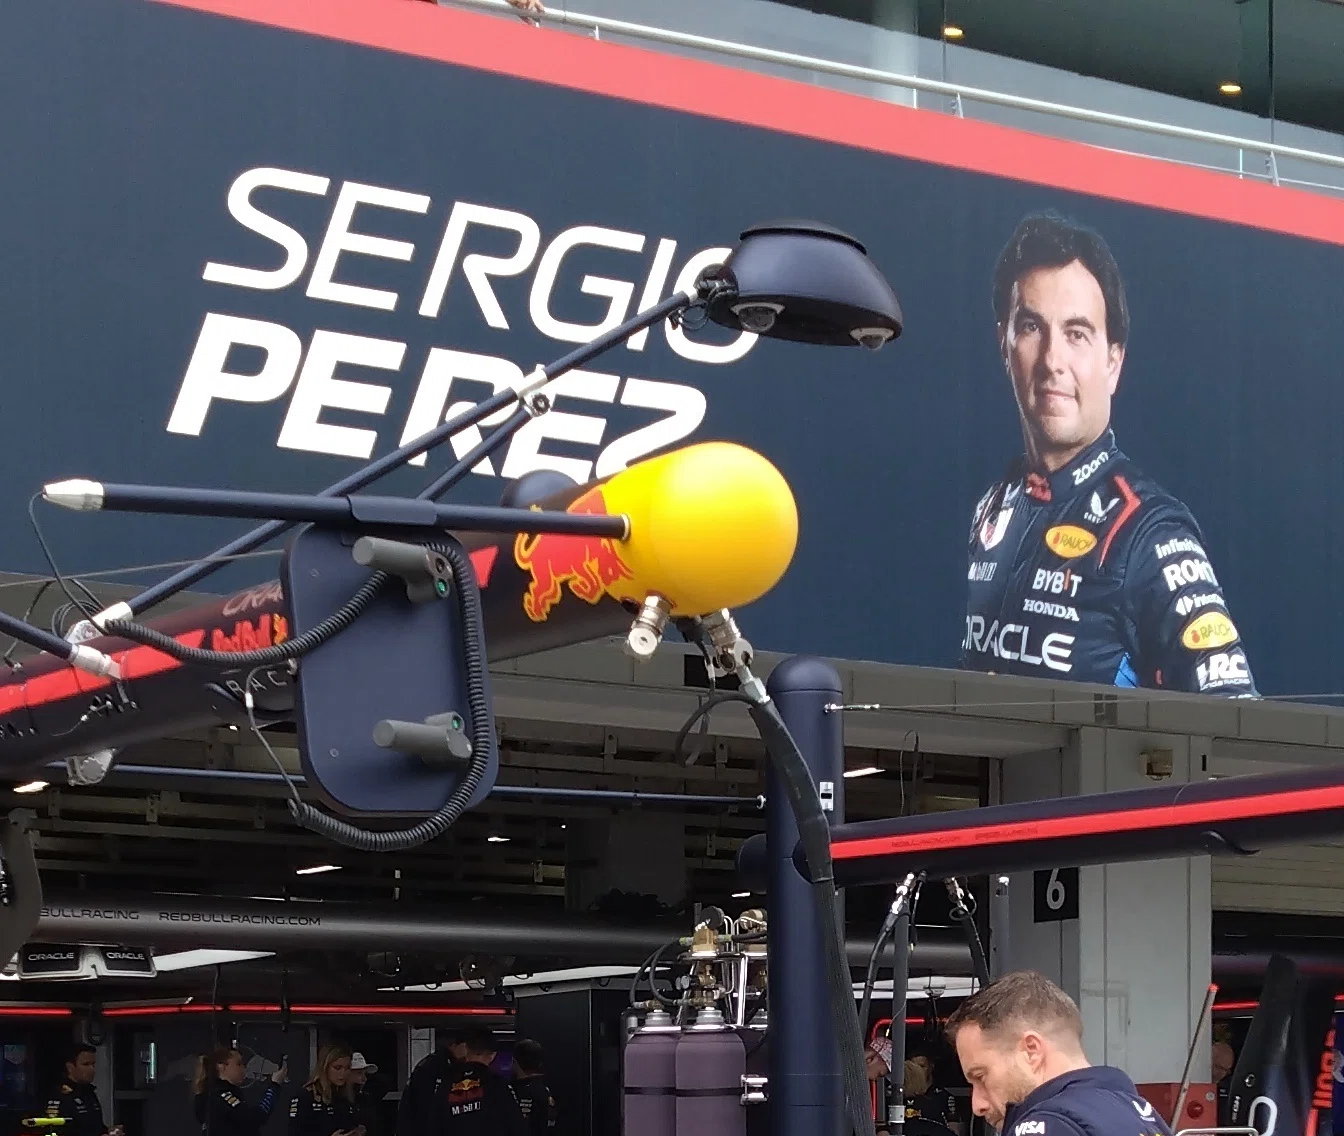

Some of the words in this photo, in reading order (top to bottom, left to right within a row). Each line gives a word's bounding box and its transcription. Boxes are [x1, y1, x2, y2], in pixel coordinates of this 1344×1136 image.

[202, 166, 760, 365] SERGIO
[166, 312, 707, 485] PEREZ
[1072, 451, 1109, 486] zoom
[1032, 568, 1082, 598] BYBIT
[1023, 598, 1080, 622] HONDA
[225, 670, 288, 696] RAC
[1046, 867, 1066, 911] 6
[39, 907, 140, 921] BULLRACING
[158, 911, 322, 926] REDBULLRACING.COM
[28, 952, 74, 962] ORACLE
[107, 952, 145, 960] ORACLE
[1014, 1121, 1045, 1136] VISA
